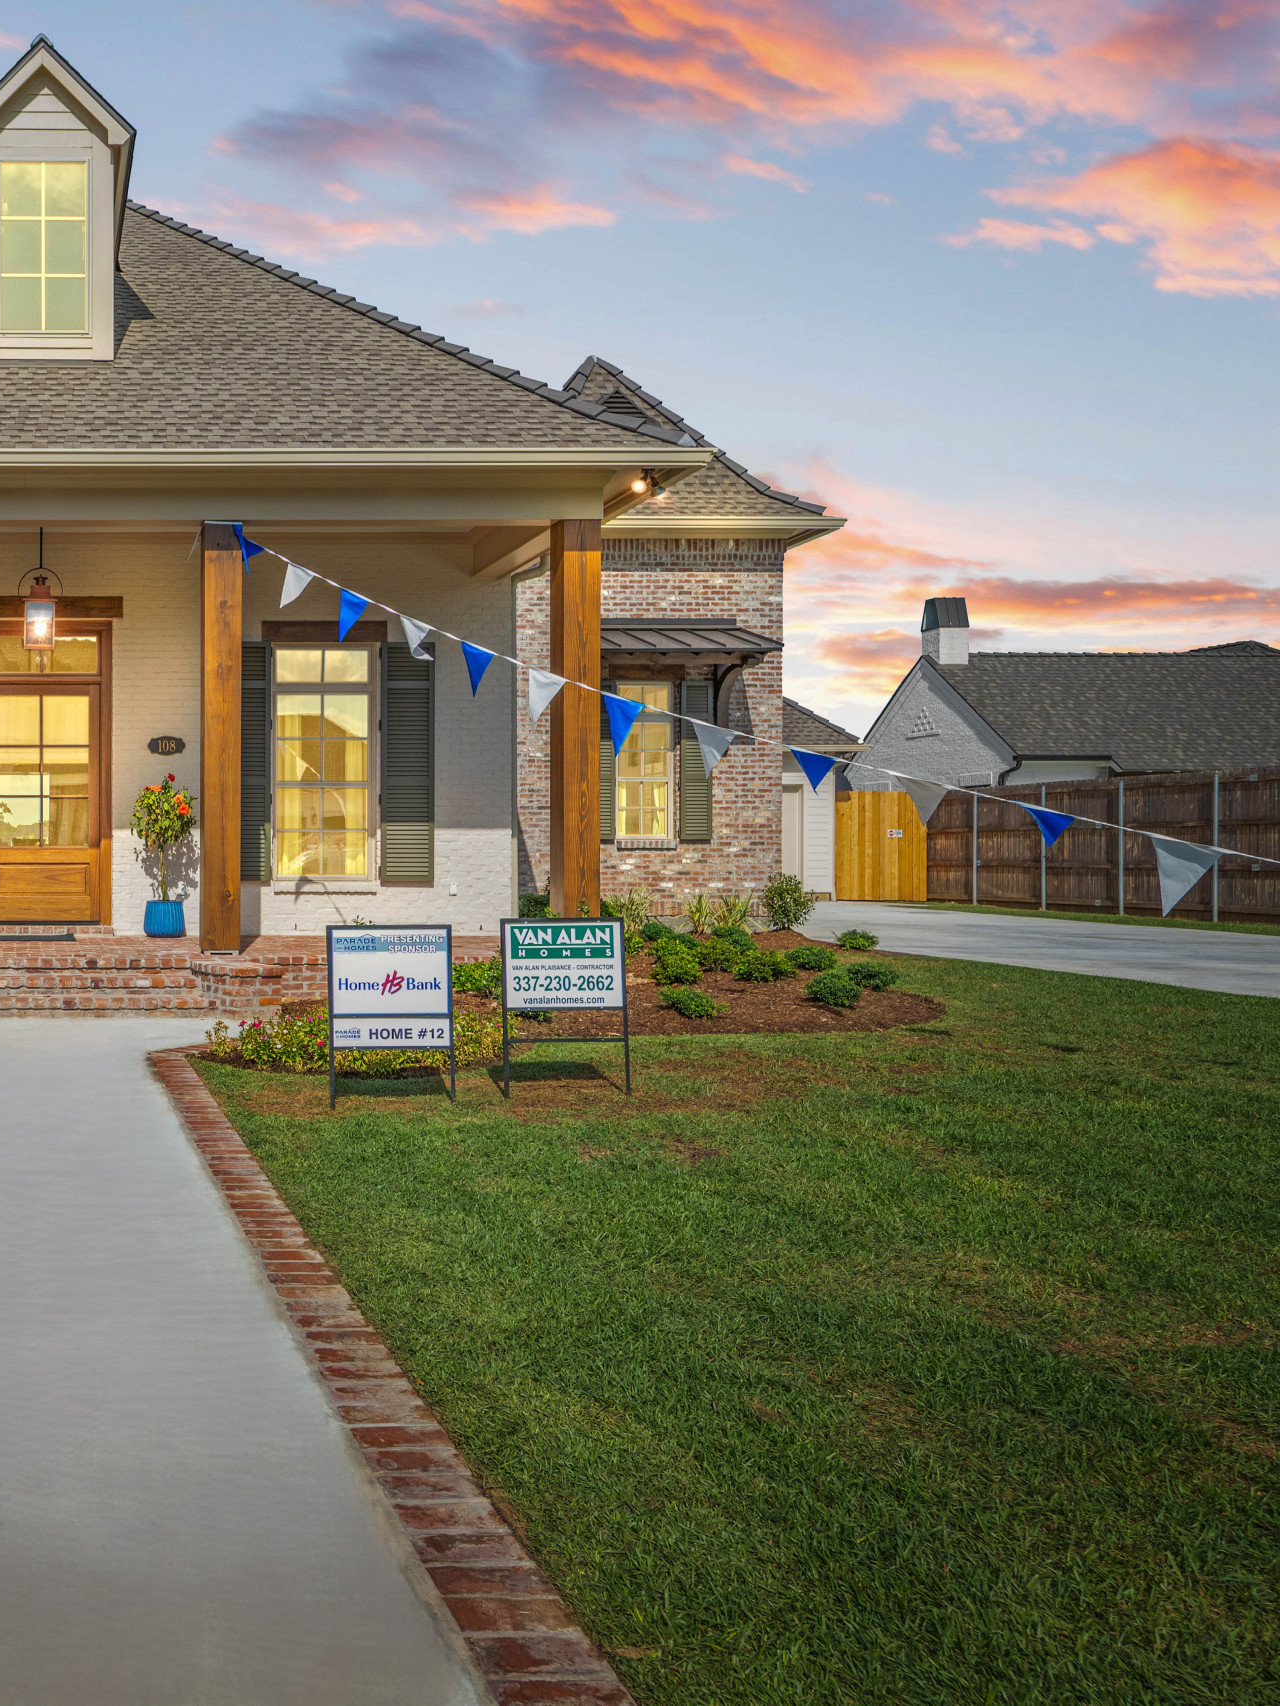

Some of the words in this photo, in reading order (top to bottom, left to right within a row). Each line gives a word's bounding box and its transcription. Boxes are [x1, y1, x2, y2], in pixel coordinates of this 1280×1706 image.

[158, 740, 176, 752] 108
[380, 934, 443, 943] PRESENTING
[513, 928, 552, 944] VAN
[556, 928, 610, 944] ALAN
[388, 945, 436, 953] SPONSOR
[518, 949, 612, 957] HOMES
[338, 977, 379, 991] Home
[406, 977, 442, 990] Bank
[513, 975, 614, 991] 337-230-2662
[523, 995, 605, 1004] vanalanhomes.com
[369, 1028, 413, 1040] HOME
[417, 1028, 445, 1039] #12
